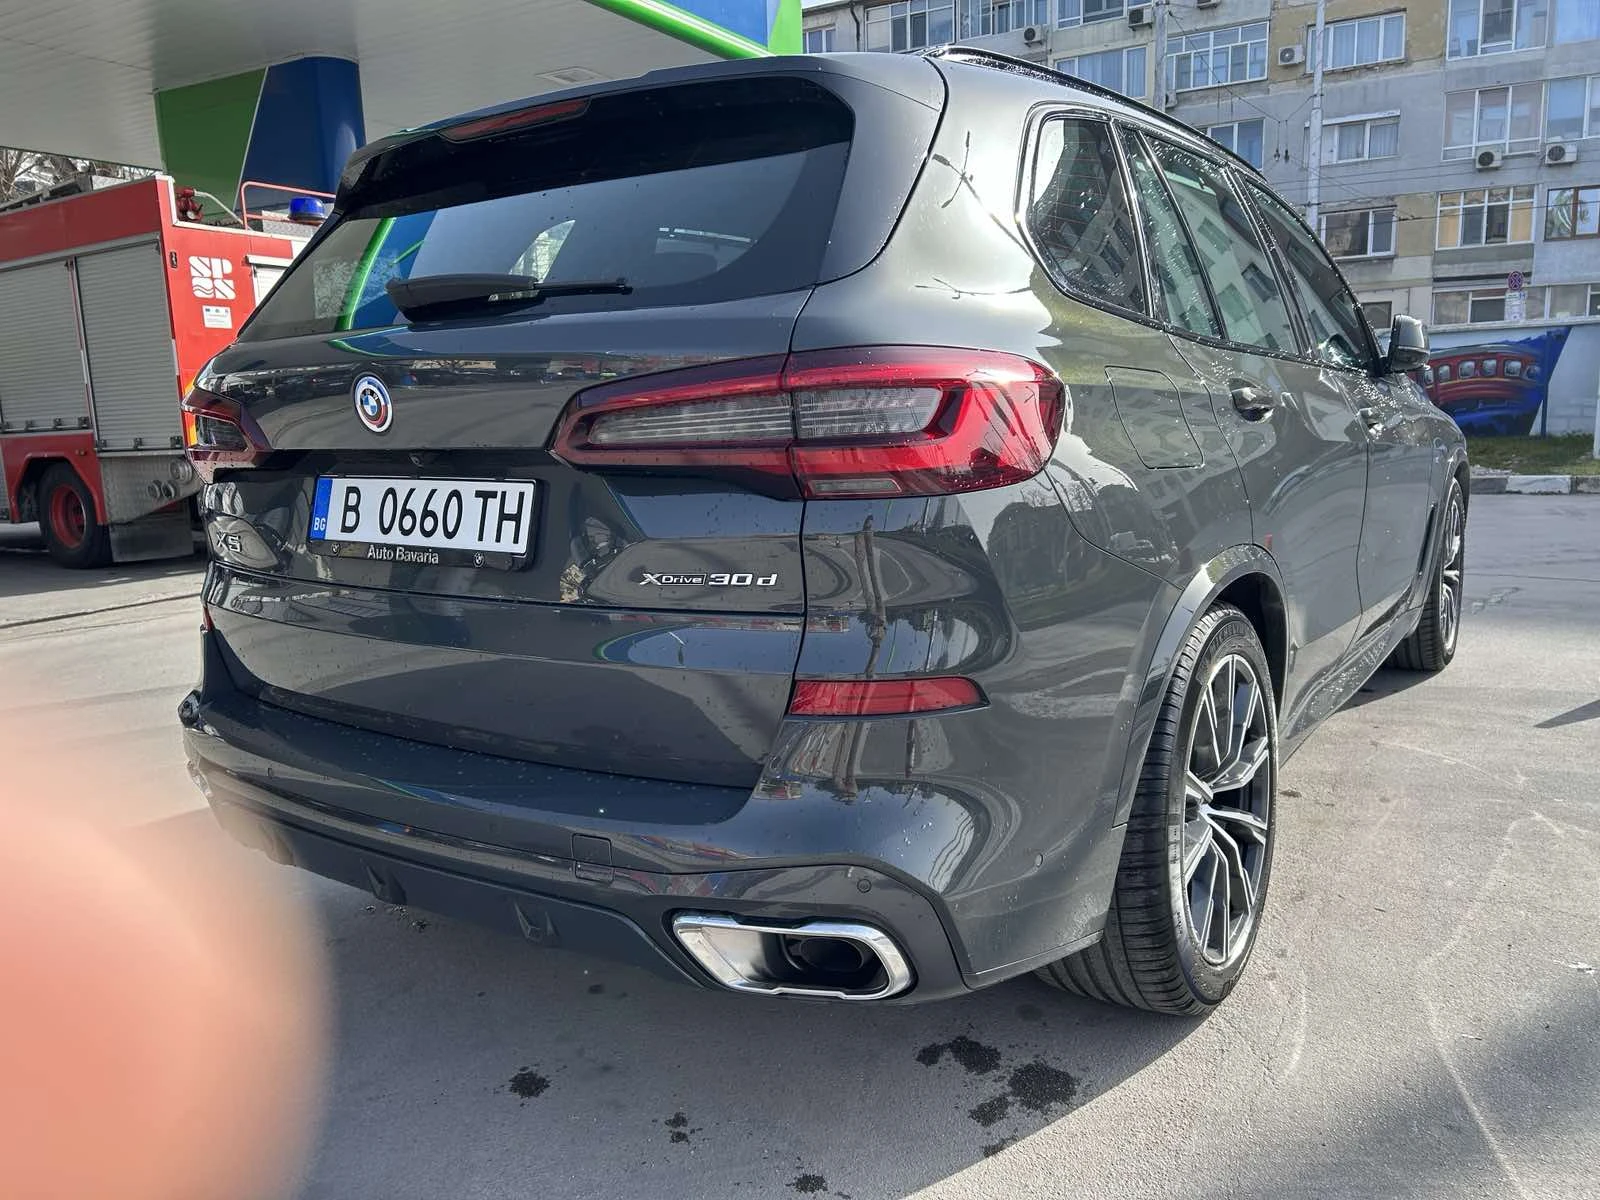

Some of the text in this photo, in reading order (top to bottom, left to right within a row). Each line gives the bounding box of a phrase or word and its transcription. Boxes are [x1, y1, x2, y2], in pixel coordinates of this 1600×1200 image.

[313, 516, 327, 532] BG
[340, 486, 526, 545] B 0660 TH
[216, 531, 242, 553] X5
[366, 544, 440, 565] Auto Bavaria
